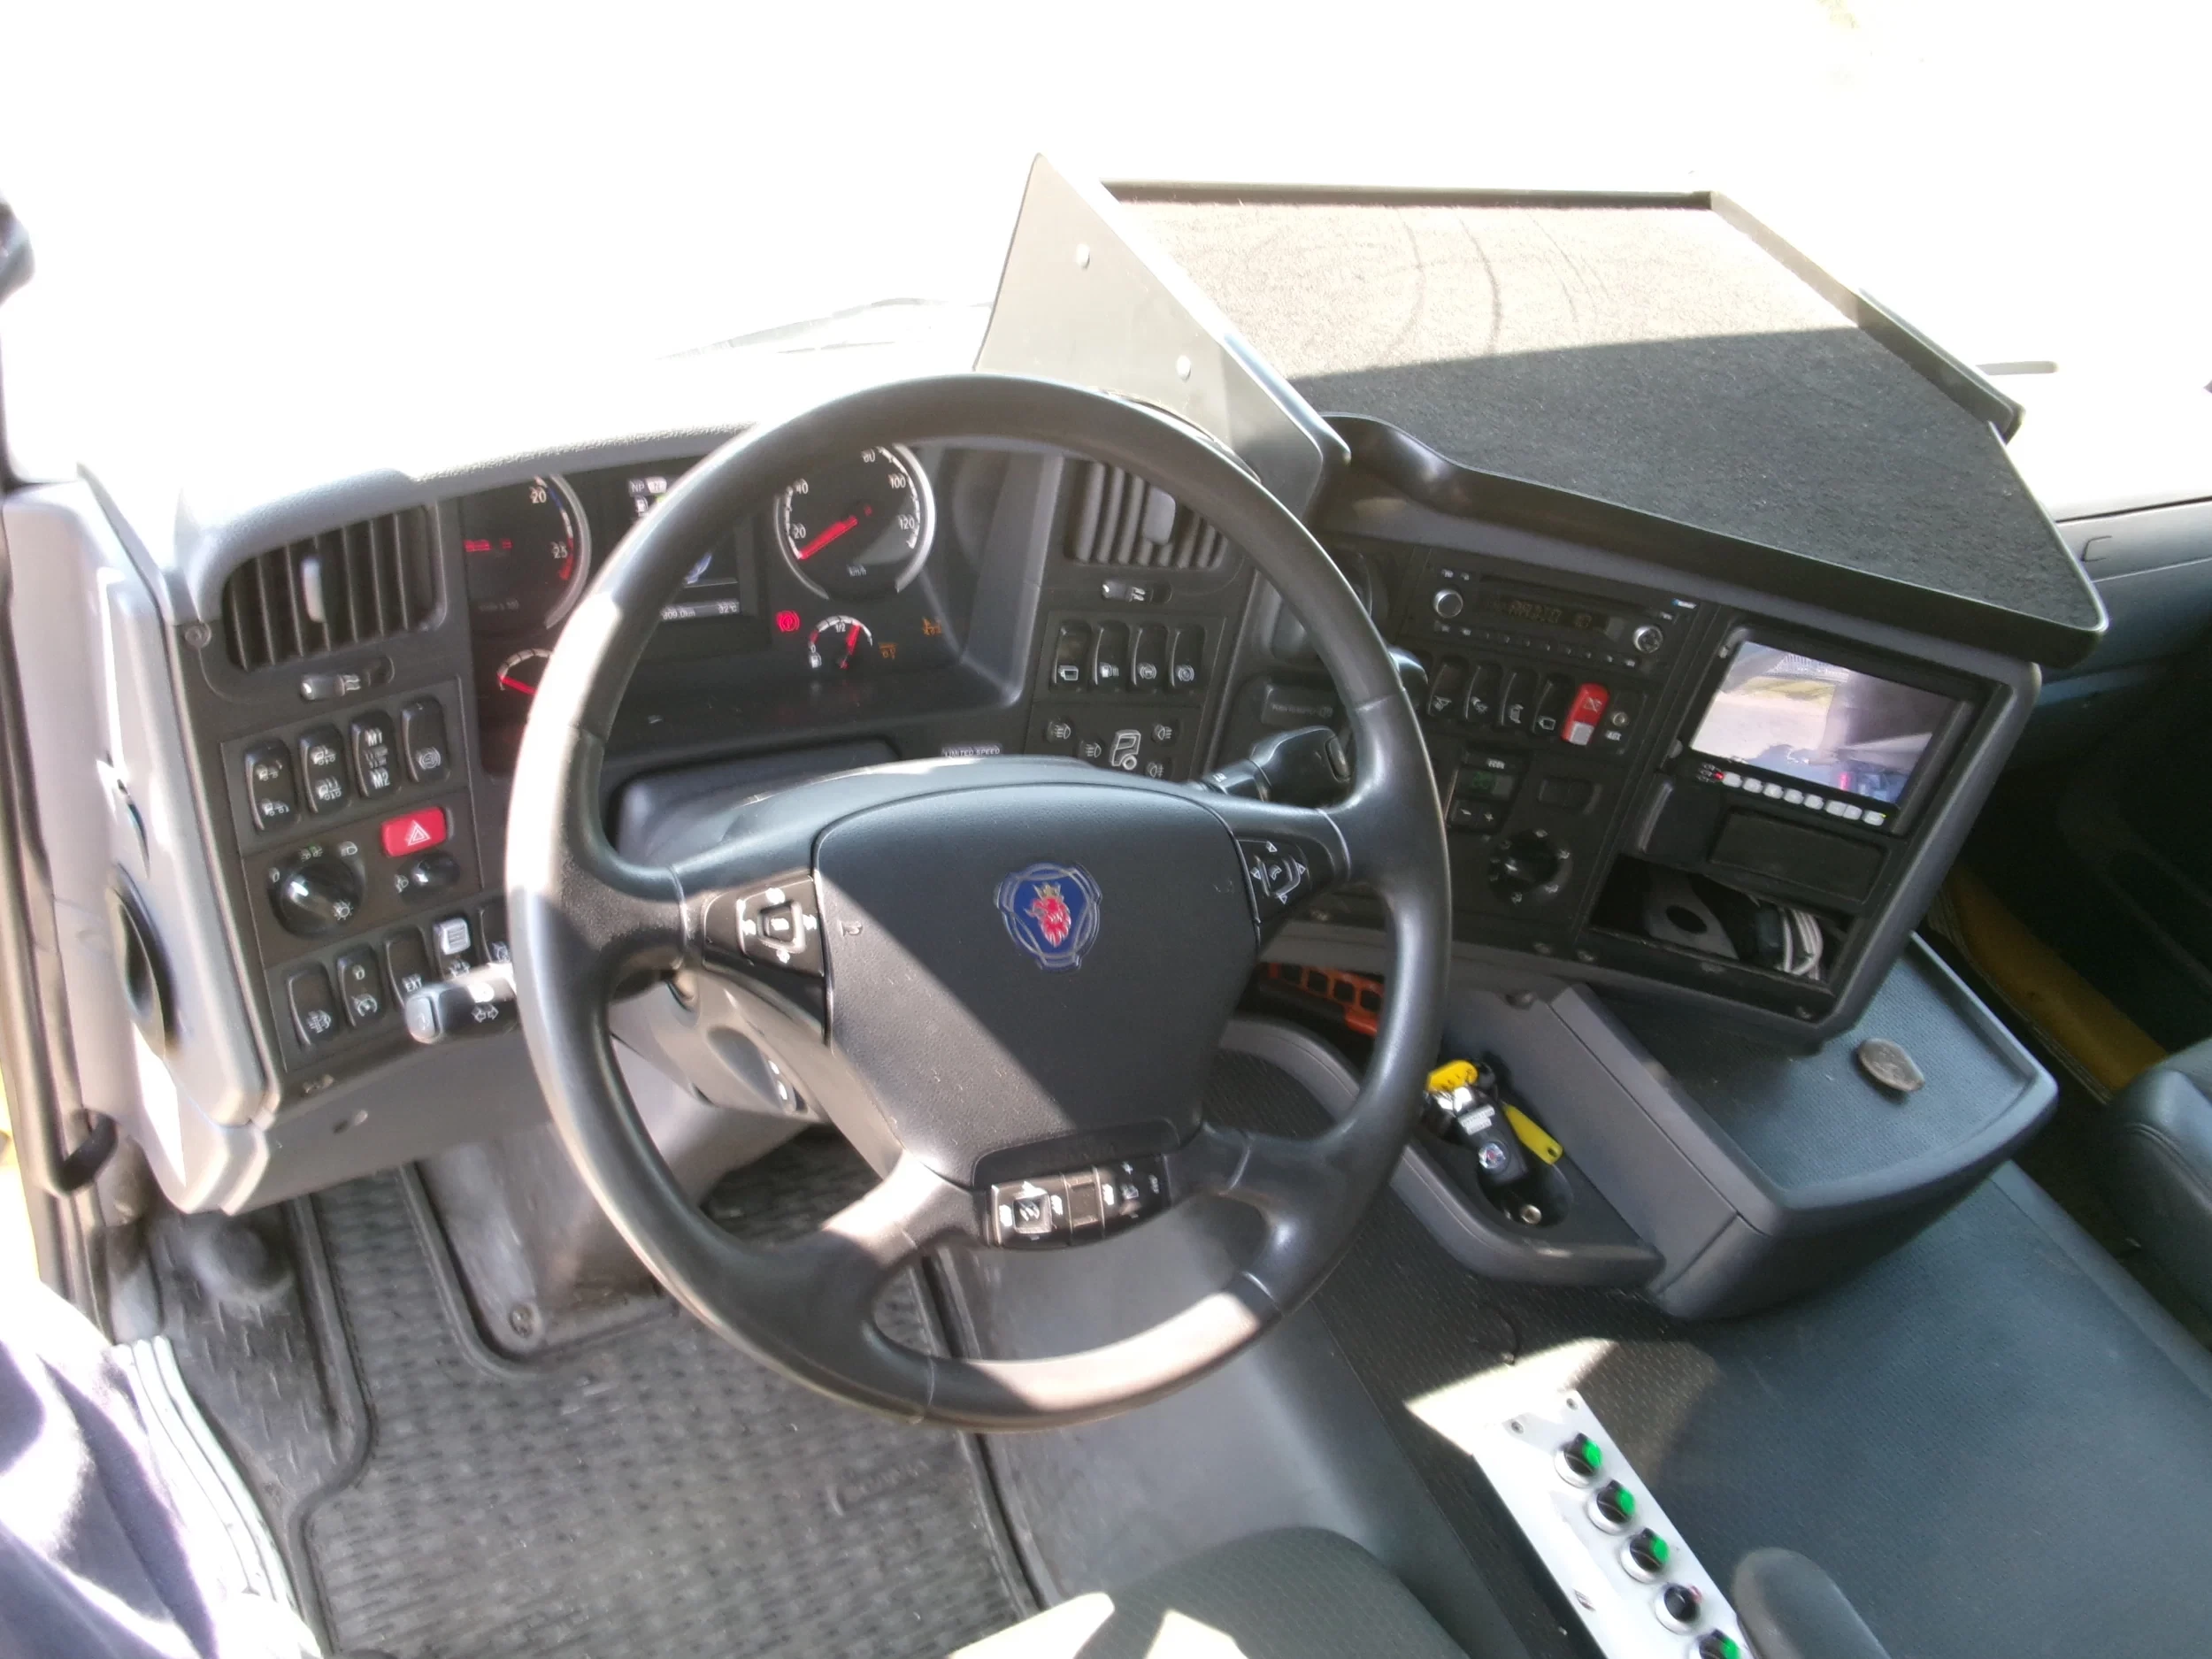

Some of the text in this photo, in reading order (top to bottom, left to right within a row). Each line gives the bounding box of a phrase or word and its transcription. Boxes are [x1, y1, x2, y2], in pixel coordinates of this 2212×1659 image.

[889, 475, 906, 488] 100
[531, 489, 547, 504] 20
[793, 523, 806, 538] 20
[899, 516, 915, 530] 120
[552, 542, 568, 559] 25
[365, 728, 382, 747] M1
[371, 768, 390, 789] M2
[403, 974, 422, 993] EXT
